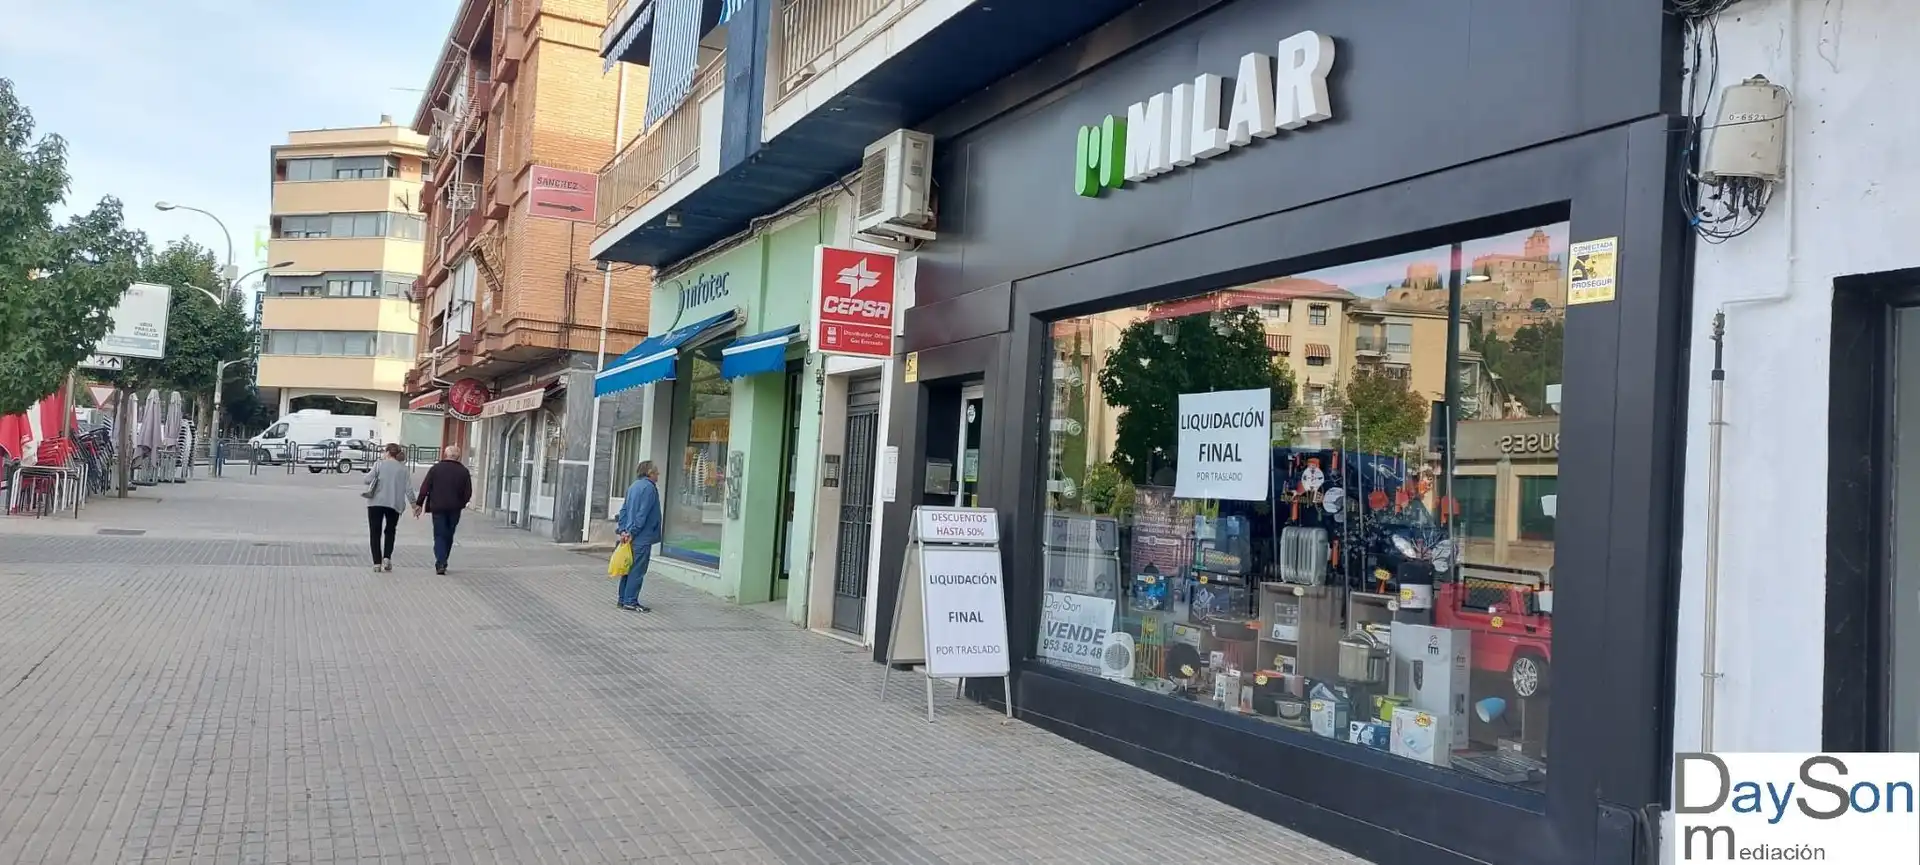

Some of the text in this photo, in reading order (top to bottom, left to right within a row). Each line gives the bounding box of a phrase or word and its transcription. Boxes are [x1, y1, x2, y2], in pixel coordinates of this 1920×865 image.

[1124, 30, 1335, 182] MILAR
[686, 271, 730, 310] infotec
[1571, 278, 1613, 289] PROSEGUR
[822, 295, 891, 319] CEPSA
[1181, 407, 1264, 432] LIQUIDACIÓN
[1198, 442, 1242, 462] FINAL
[1196, 471, 1242, 481] POR TRASLADO
[931, 513, 987, 523] DESCUENTOS
[936, 527, 985, 536] HASTA 50%
[929, 573, 997, 586] LIQUIDACIÓN
[1044, 592, 1081, 612] DaySon
[948, 611, 984, 623] FINAL
[1047, 621, 1106, 645] VENDE
[936, 645, 1000, 655] POR TRASLADO
[1043, 638, 1103, 660] 953 58 23 48
